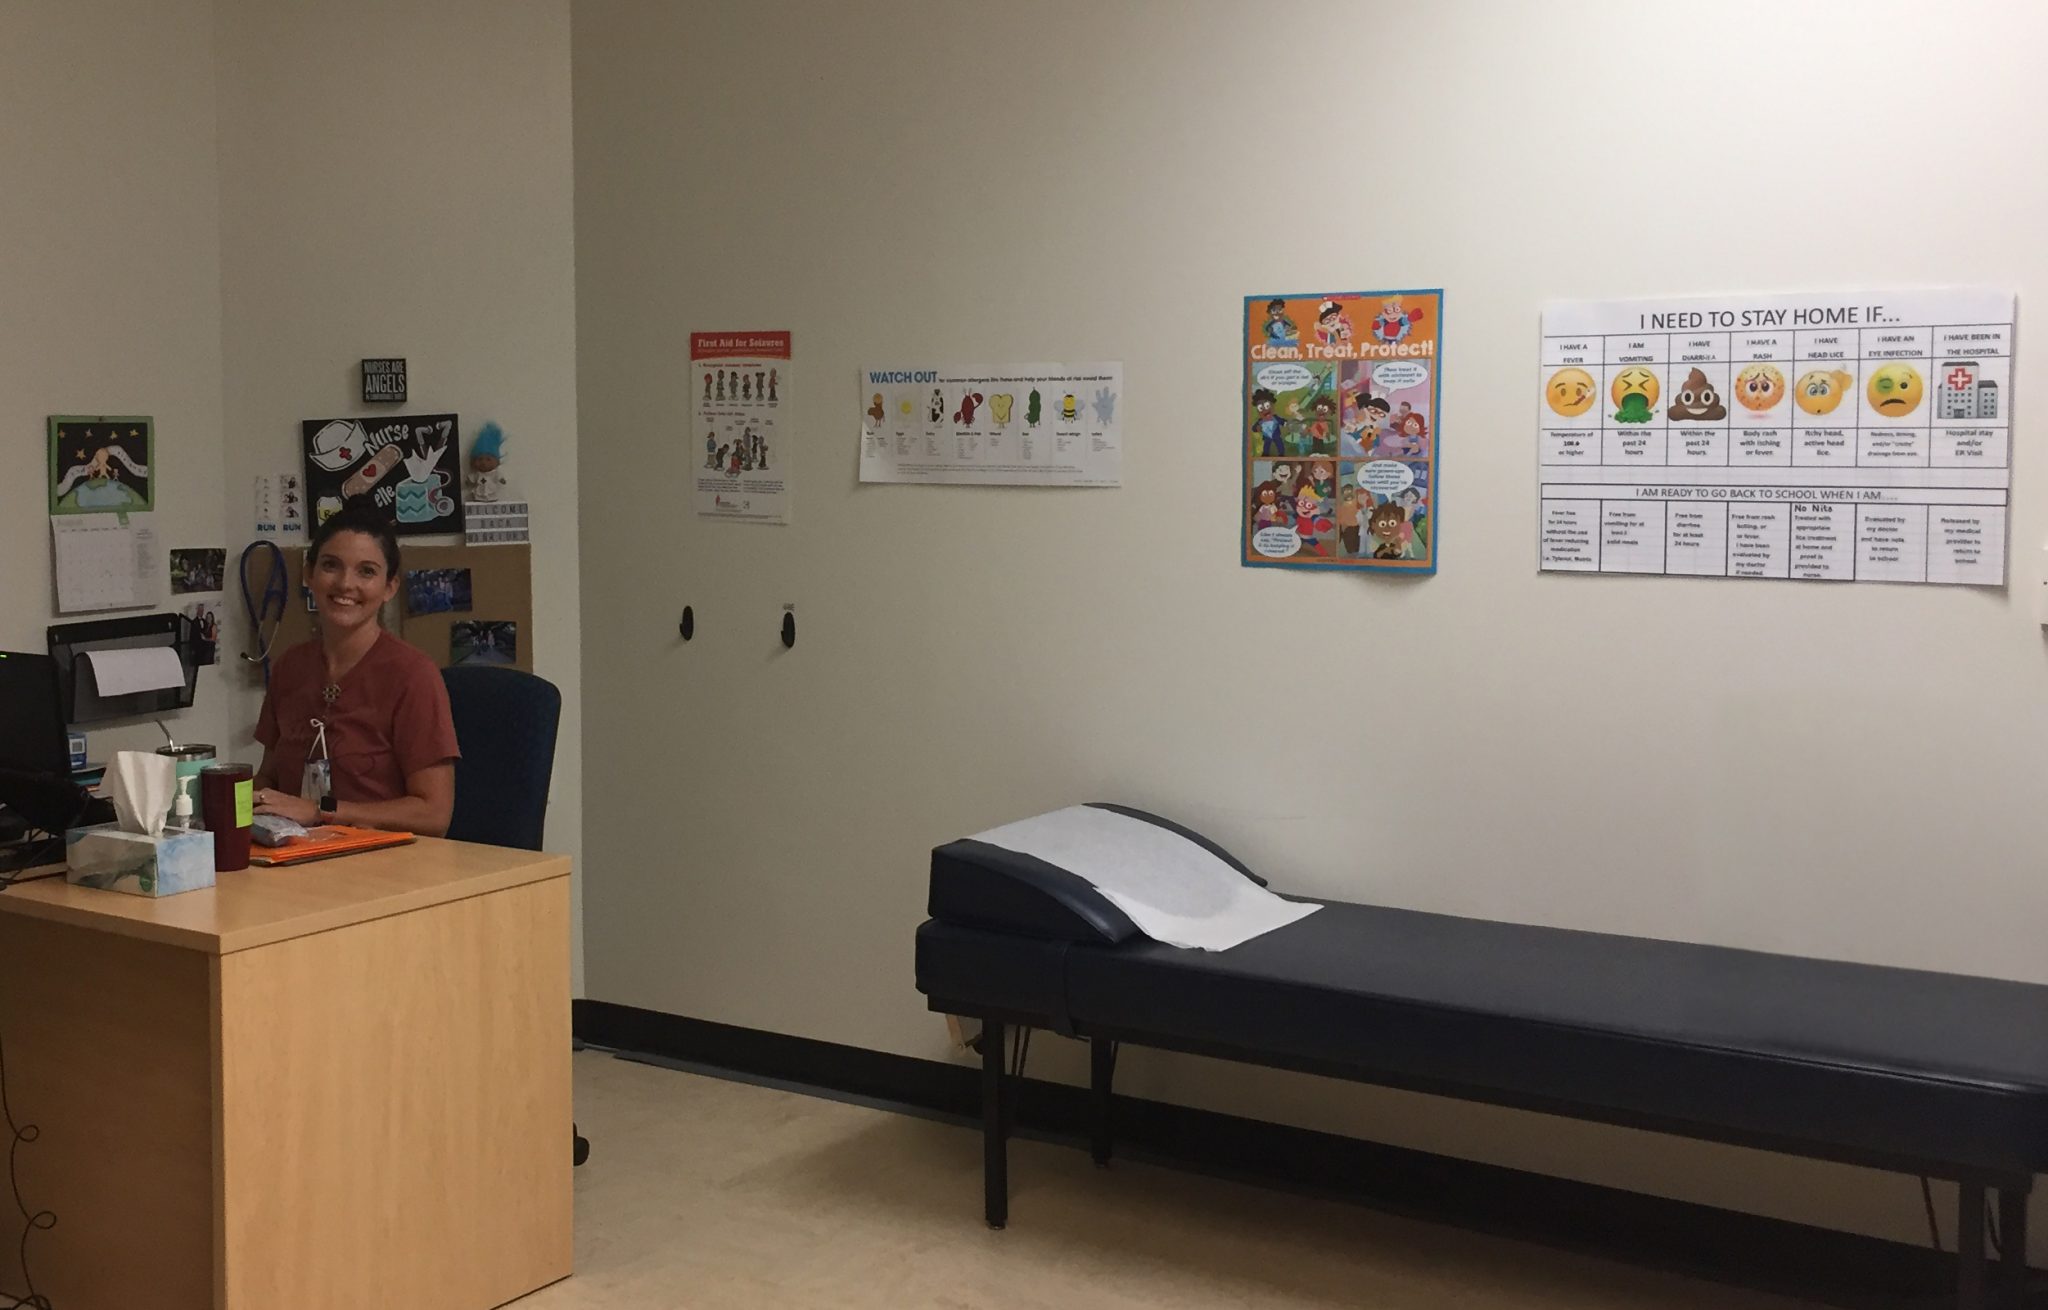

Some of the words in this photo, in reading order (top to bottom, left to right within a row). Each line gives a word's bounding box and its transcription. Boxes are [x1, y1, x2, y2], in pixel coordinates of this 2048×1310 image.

[1640, 314, 1645, 329] I
[1651, 312, 1703, 329] NEED
[1708, 310, 1735, 327] TO
[1741, 309, 1788, 326] STAY
[1794, 306, 1859, 324] HOME
[1819, 337, 1838, 345] HAVE
[1882, 335, 1902, 343] HAVE
[1903, 335, 1915, 343] AN
[1948, 333, 1969, 341] HAVE
[1970, 333, 1991, 341] BEEN
[1992, 333, 2001, 341] IN
[698, 338, 718, 348] First
[719, 338, 734, 348] Aid
[735, 338, 747, 347] for
[748, 338, 784, 348] Seizures
[1563, 343, 1582, 351] HAVE
[1582, 343, 1588, 351] A
[1250, 343, 1303, 361] Clean,
[1305, 342, 1358, 359] Treat,
[1360, 340, 1435, 358] Protect!
[1868, 349, 1882, 357] EYE
[1883, 349, 1923, 357] INFECTION
[1946, 348, 1961, 356] THE
[1963, 348, 2000, 356] HOSPITAL
[1619, 355, 1654, 363] VOMITING
[1808, 351, 1827, 359] HEAD
[1829, 351, 1844, 359] LICE
[364, 360, 391, 374] NURSES
[391, 360, 405, 374] ARE
[869, 371, 913, 384] WATCH
[913, 371, 938, 384] OUT
[365, 374, 406, 393] ANGELS
[1743, 430, 1760, 438] Body
[1762, 430, 1778, 438] rash
[363, 424, 410, 457] Nurse
[1739, 440, 1756, 448] with
[1757, 440, 1781, 448] itching
[1954, 449, 1966, 457] ER
[1966, 449, 1983, 457] Visit
[374, 484, 396, 508] elle
[1641, 488, 1659, 497] AM
[1661, 488, 1693, 497] READY
[1695, 488, 1709, 497] TO
[1711, 488, 1727, 497] GO
[1730, 488, 1757, 497] BACK
[1759, 490, 1773, 499] TO
[1775, 490, 1817, 499] SCHOOL
[1820, 490, 1854, 499] WHEN
[1794, 504, 1807, 513] No
[1812, 504, 1834, 513] Nits
